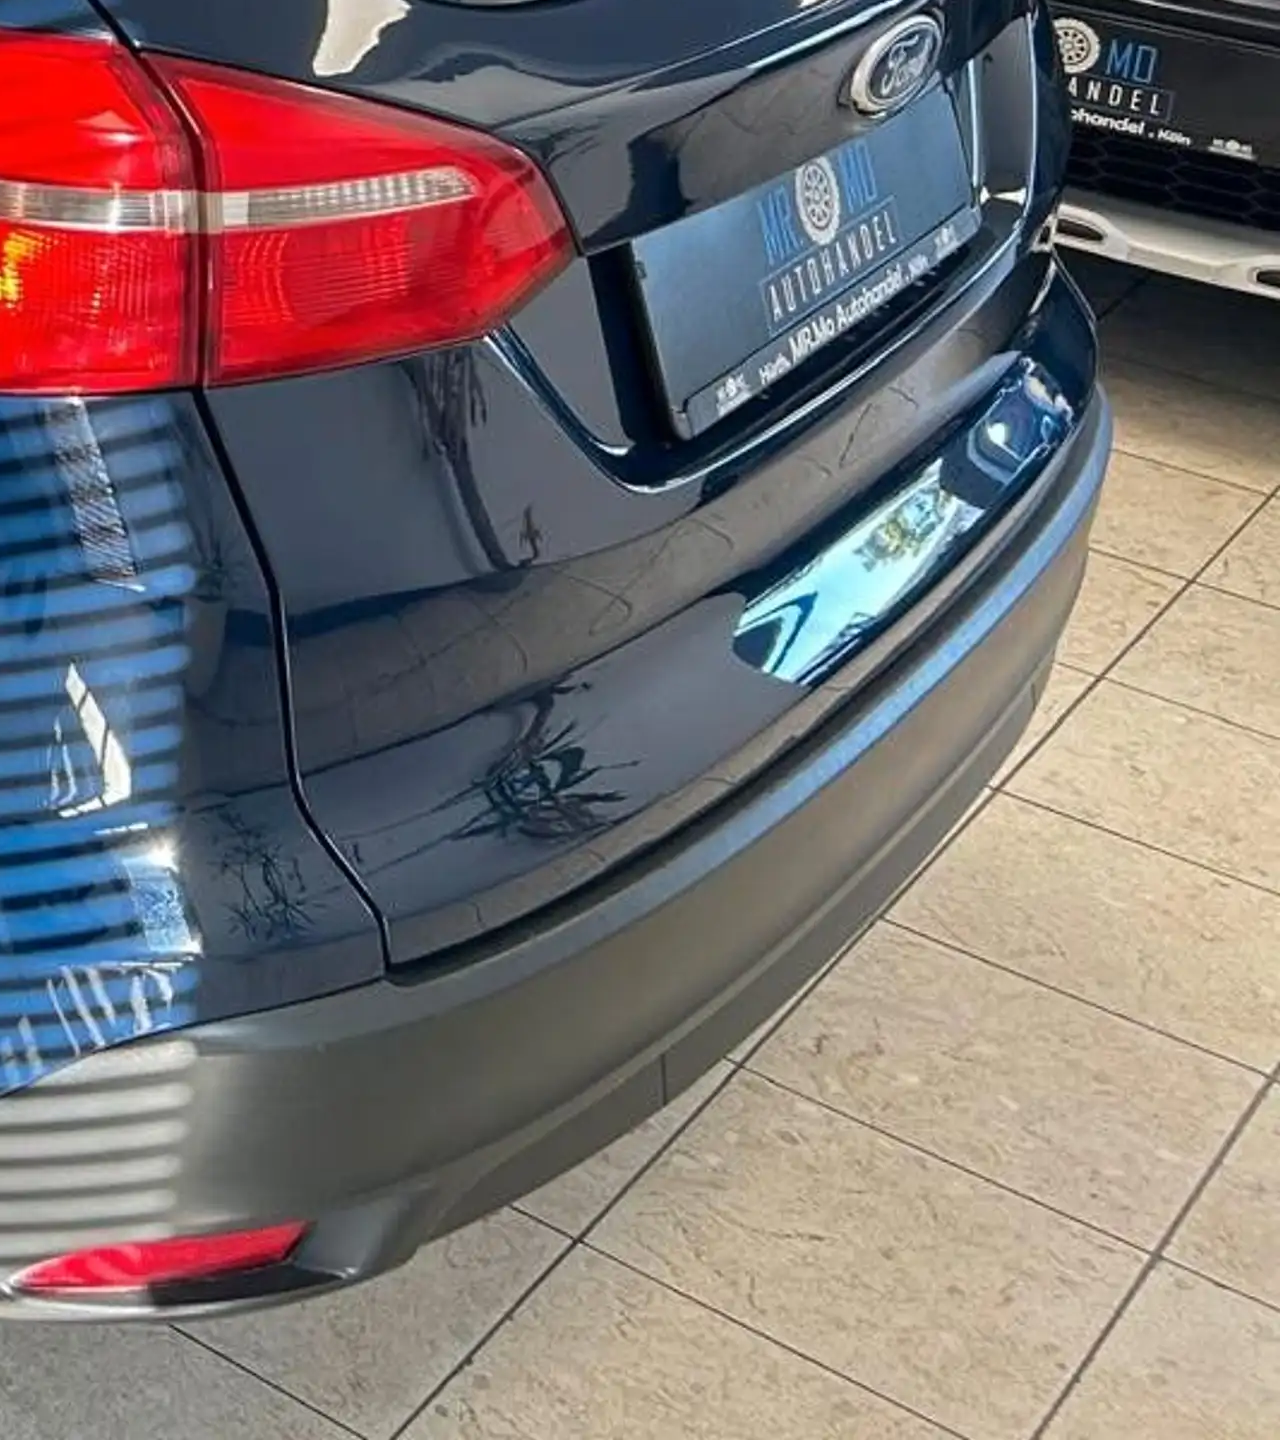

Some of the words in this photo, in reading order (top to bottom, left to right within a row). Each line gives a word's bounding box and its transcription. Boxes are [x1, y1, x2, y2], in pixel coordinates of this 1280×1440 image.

[880, 31, 934, 97] Ford
[1105, 38, 1158, 84] MO
[1068, 75, 1165, 116] ANDEL
[838, 138, 878, 215] MO
[769, 210, 897, 324] AUTOHANDEL
